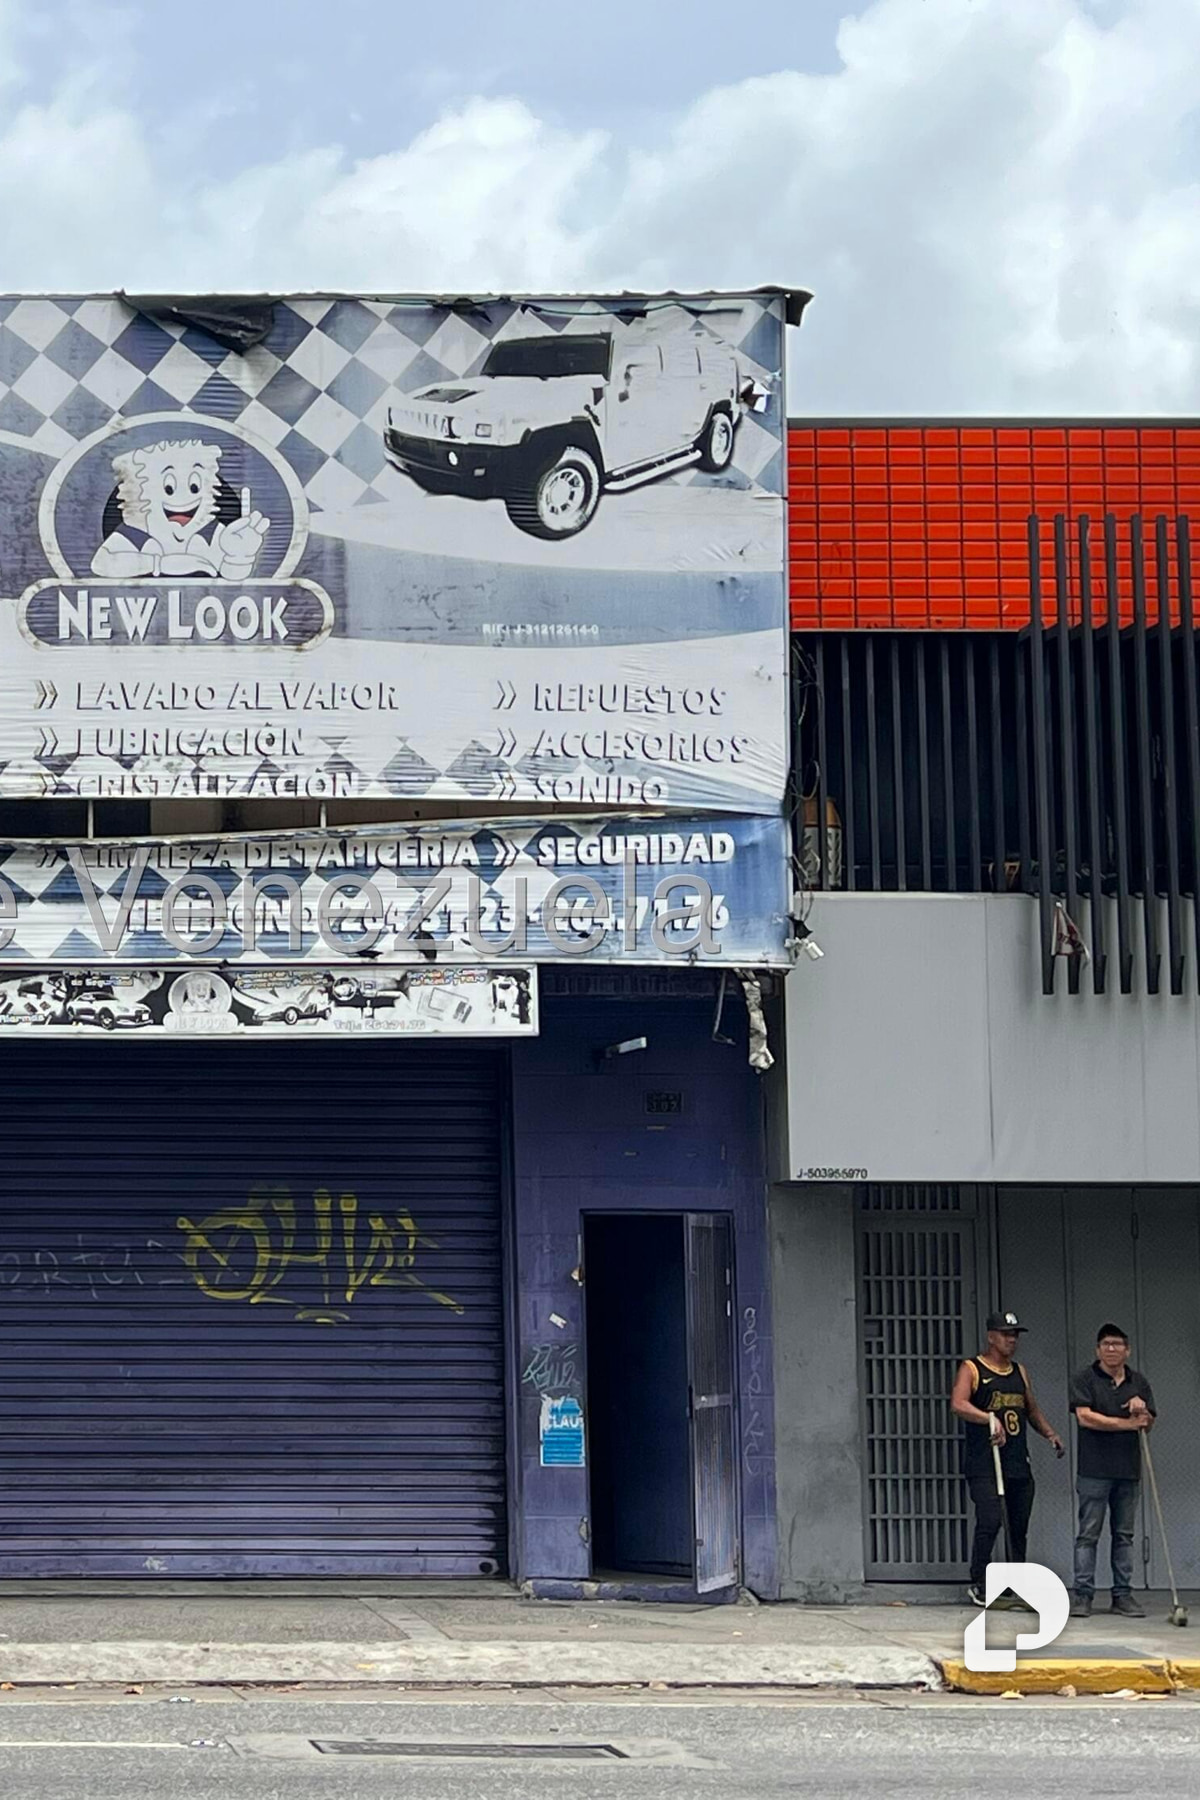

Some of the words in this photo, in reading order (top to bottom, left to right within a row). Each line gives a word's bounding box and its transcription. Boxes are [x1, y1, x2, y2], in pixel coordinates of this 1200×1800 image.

[58, 589, 158, 642] NEW
[167, 590, 290, 641] LOOK
[75, 681, 216, 711] LAVADO
[226, 681, 274, 711] AL
[279, 681, 402, 711] VAPOR
[533, 682, 728, 716] REPUESTOS
[531, 728, 750, 763] ACCESORIOS
[533, 773, 669, 804] SONIDO
[244, 841, 295, 868] DE
[536, 832, 736, 867] SEGURIDAD
